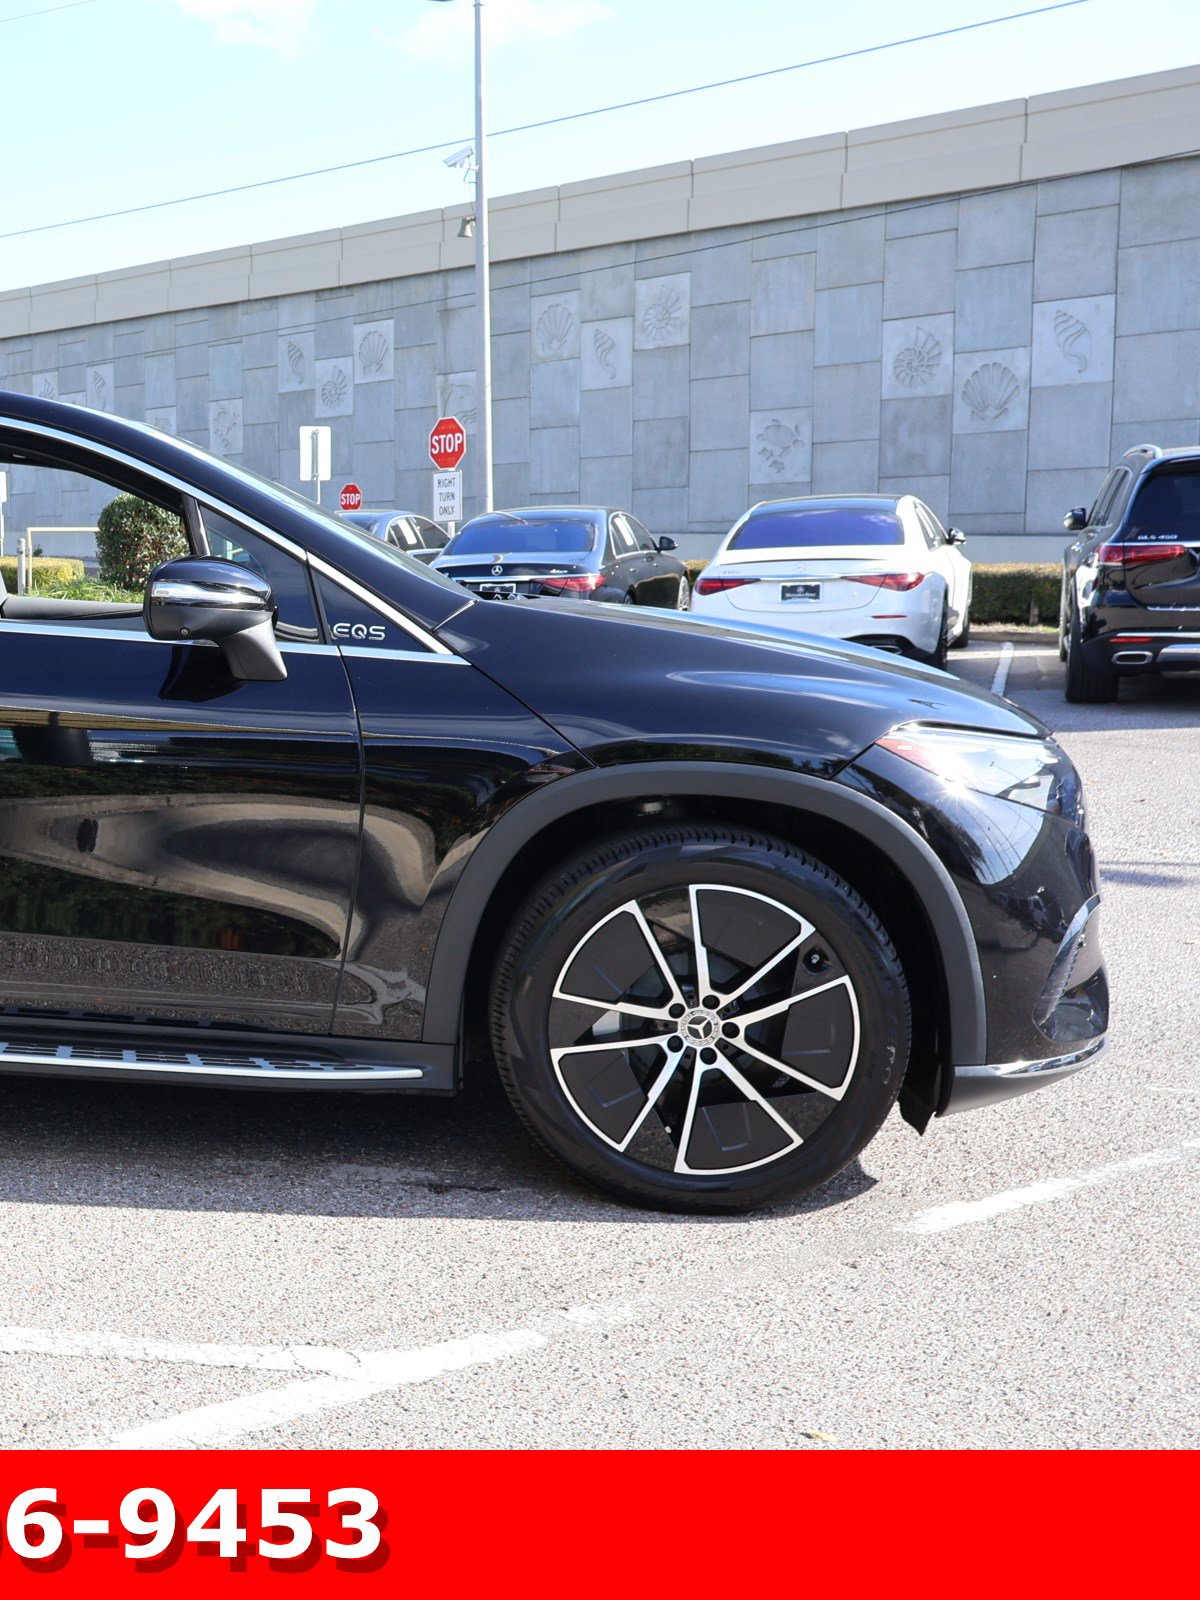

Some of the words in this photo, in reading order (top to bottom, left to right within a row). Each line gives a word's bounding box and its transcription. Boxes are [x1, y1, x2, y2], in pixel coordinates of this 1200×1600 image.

[431, 432, 463, 455] STOP
[437, 477, 456, 488] RIGHT
[341, 493, 361, 505] STOP
[439, 492, 456, 502] TURN
[438, 506, 455, 516] ONLY
[333, 622, 386, 641] EQS
